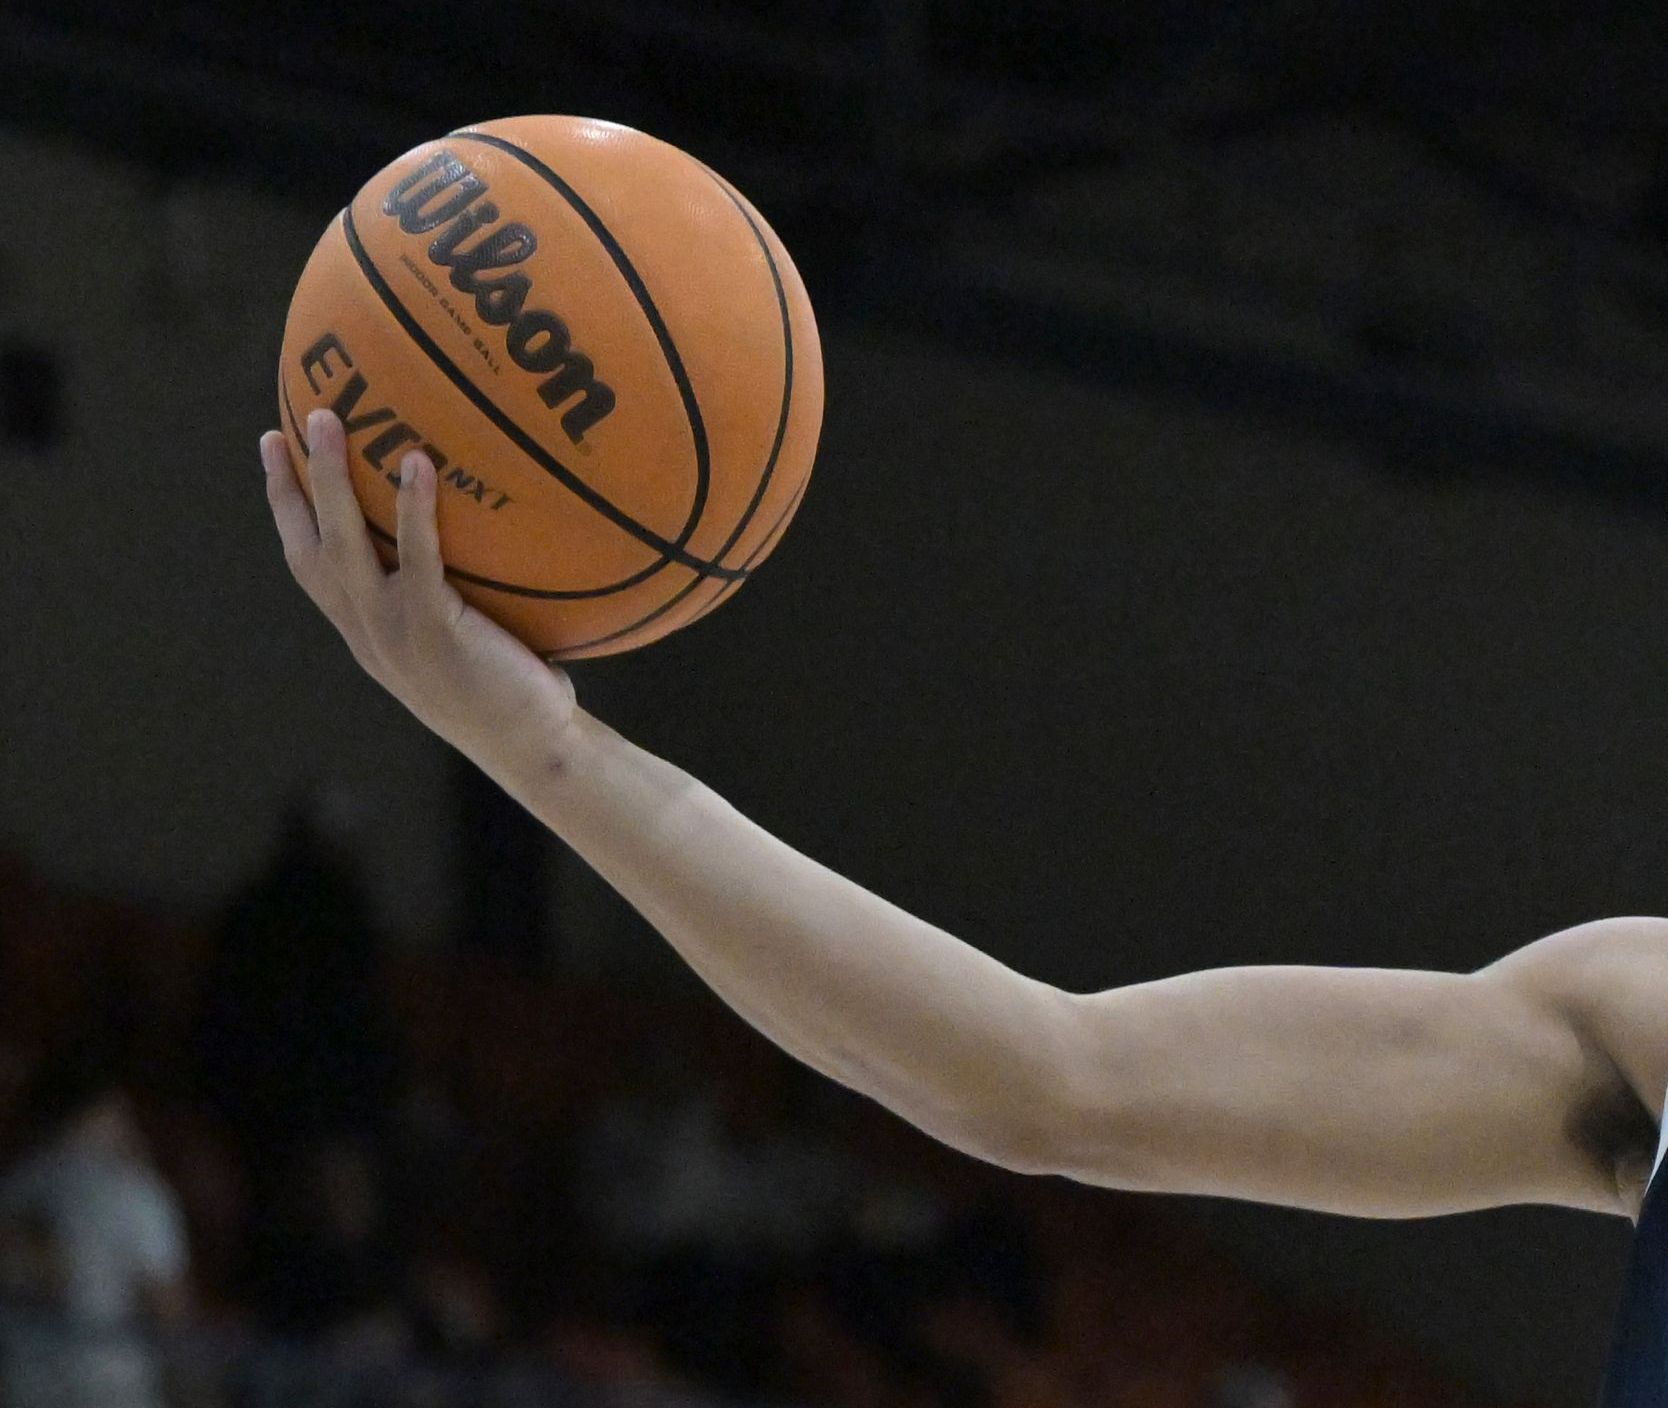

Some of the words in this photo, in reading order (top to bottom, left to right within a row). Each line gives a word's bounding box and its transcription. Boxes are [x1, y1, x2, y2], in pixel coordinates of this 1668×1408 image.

[383, 151, 617, 447] Wilson
[473, 338, 499, 375] BALL
[446, 466, 513, 511] NXT
